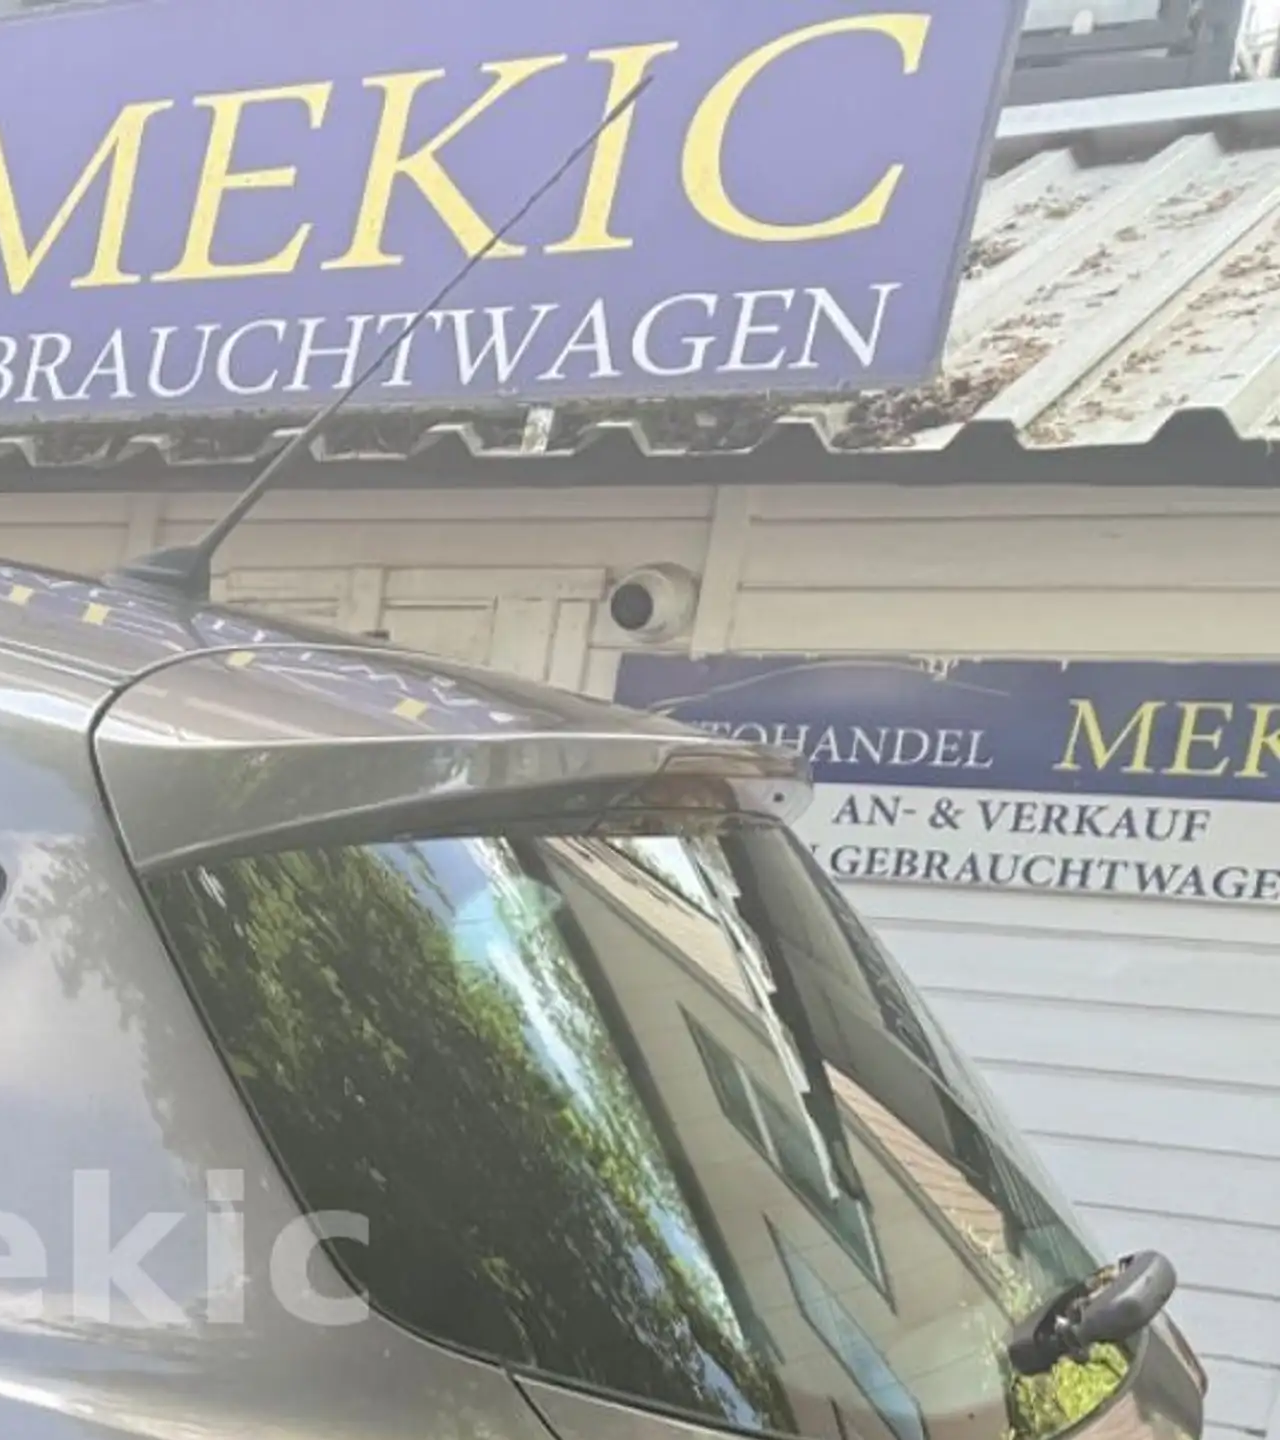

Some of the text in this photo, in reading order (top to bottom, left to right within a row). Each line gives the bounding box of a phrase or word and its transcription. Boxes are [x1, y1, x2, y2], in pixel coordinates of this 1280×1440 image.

[700, 720, 994, 770] TOHANDEL
[832, 794, 1211, 842] AN- & VERKAUF
